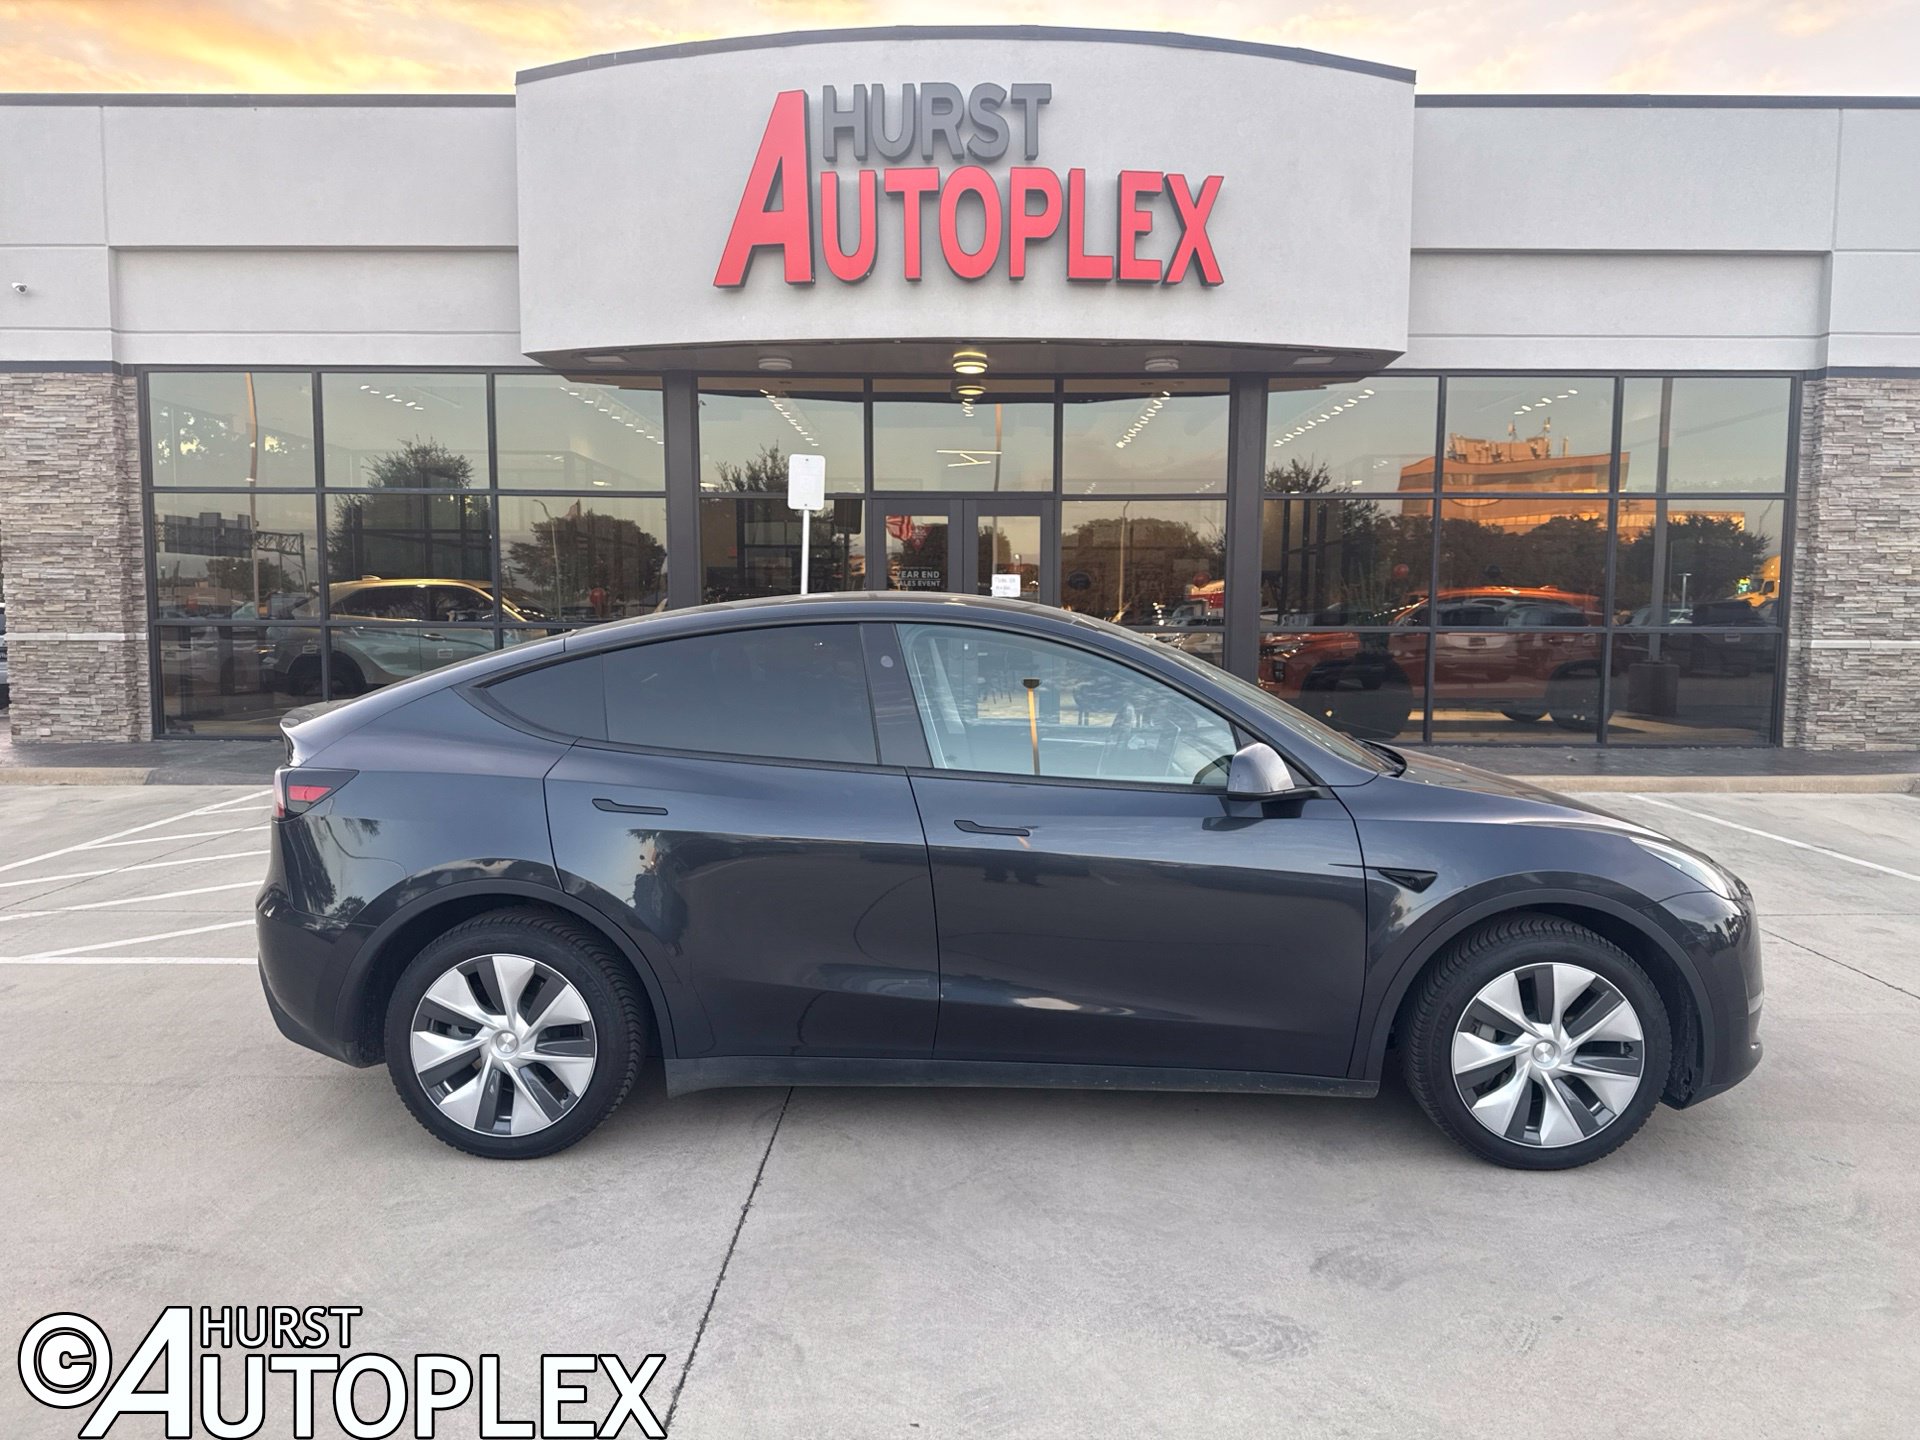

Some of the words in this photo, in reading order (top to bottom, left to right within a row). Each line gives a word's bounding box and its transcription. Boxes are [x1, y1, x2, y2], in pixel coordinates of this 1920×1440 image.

[822, 82, 1052, 162] HURST
[713, 89, 1225, 288] AUTOPLEX
[895, 570, 920, 579] YEAR
[921, 570, 940, 579] END
